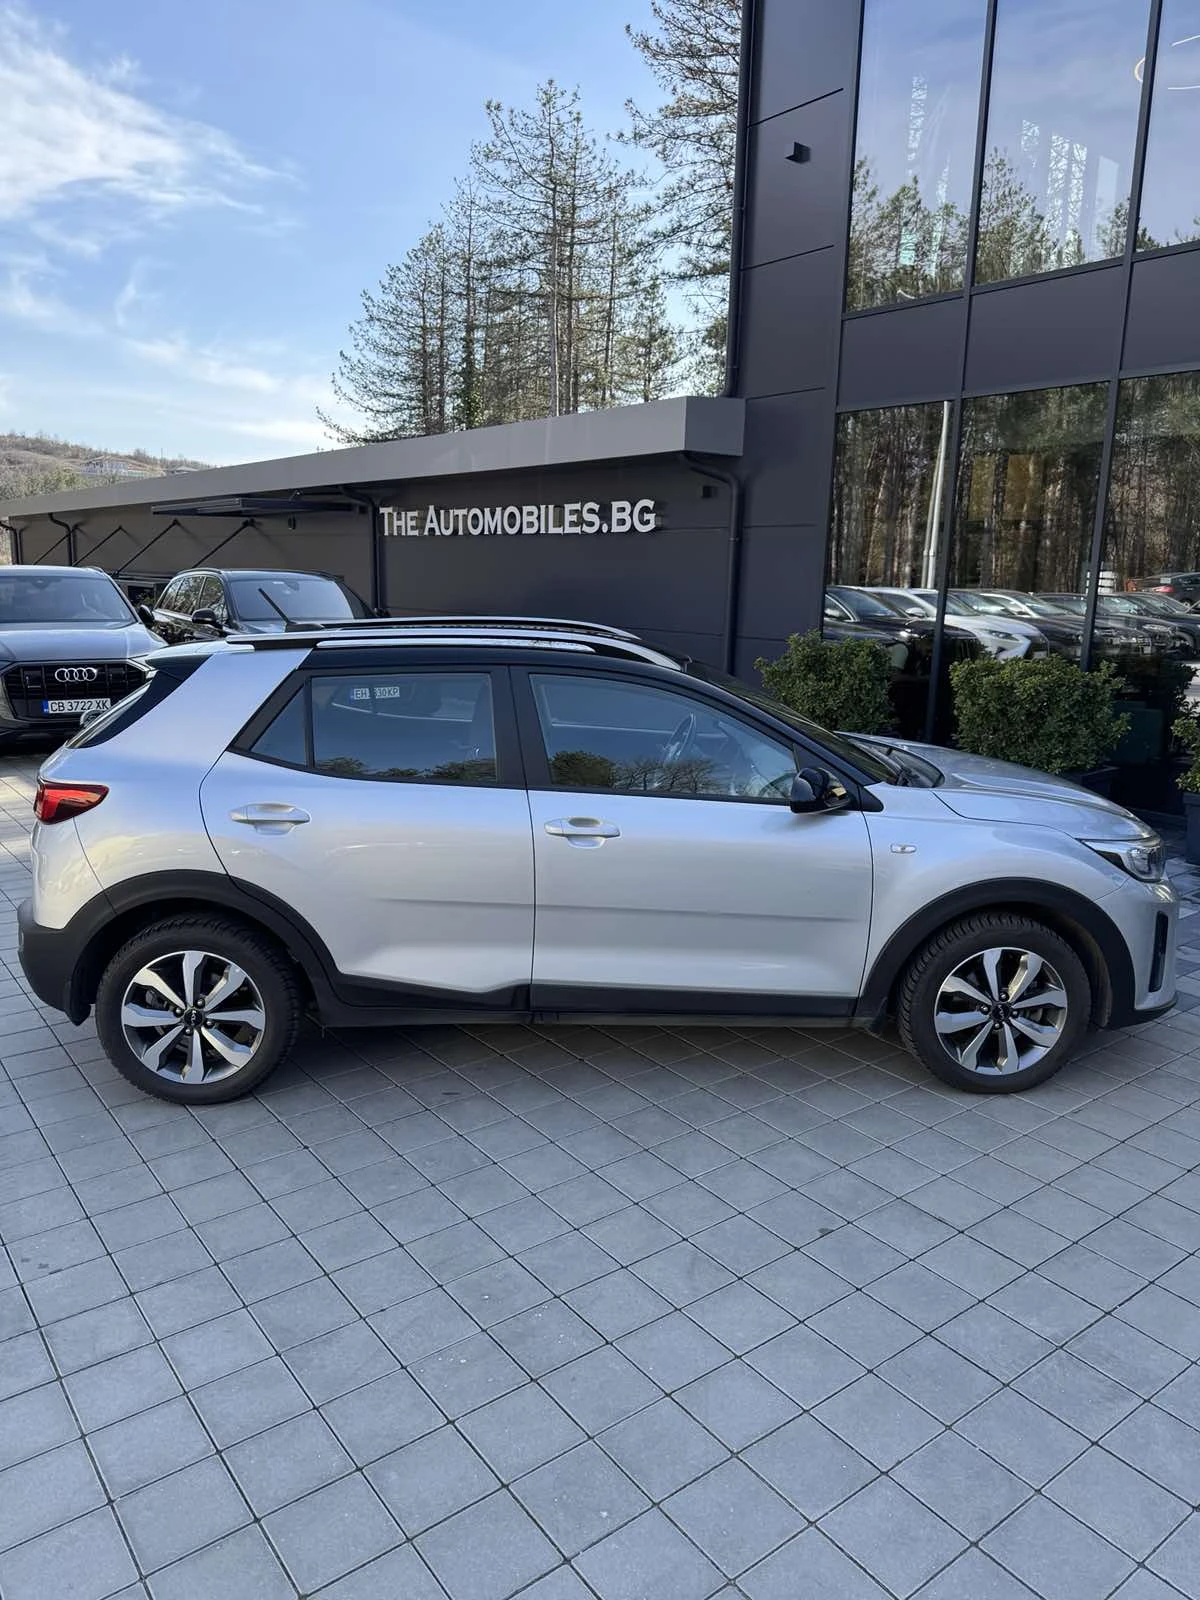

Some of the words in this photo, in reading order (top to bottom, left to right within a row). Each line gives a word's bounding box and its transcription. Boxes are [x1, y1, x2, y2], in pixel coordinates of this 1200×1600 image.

[379, 506, 419, 537] THE
[423, 499, 657, 536] AUTOMOBILES.BG
[50, 701, 65, 712] CB
[67, 700, 93, 712] 3722
[95, 700, 109, 710] XK
